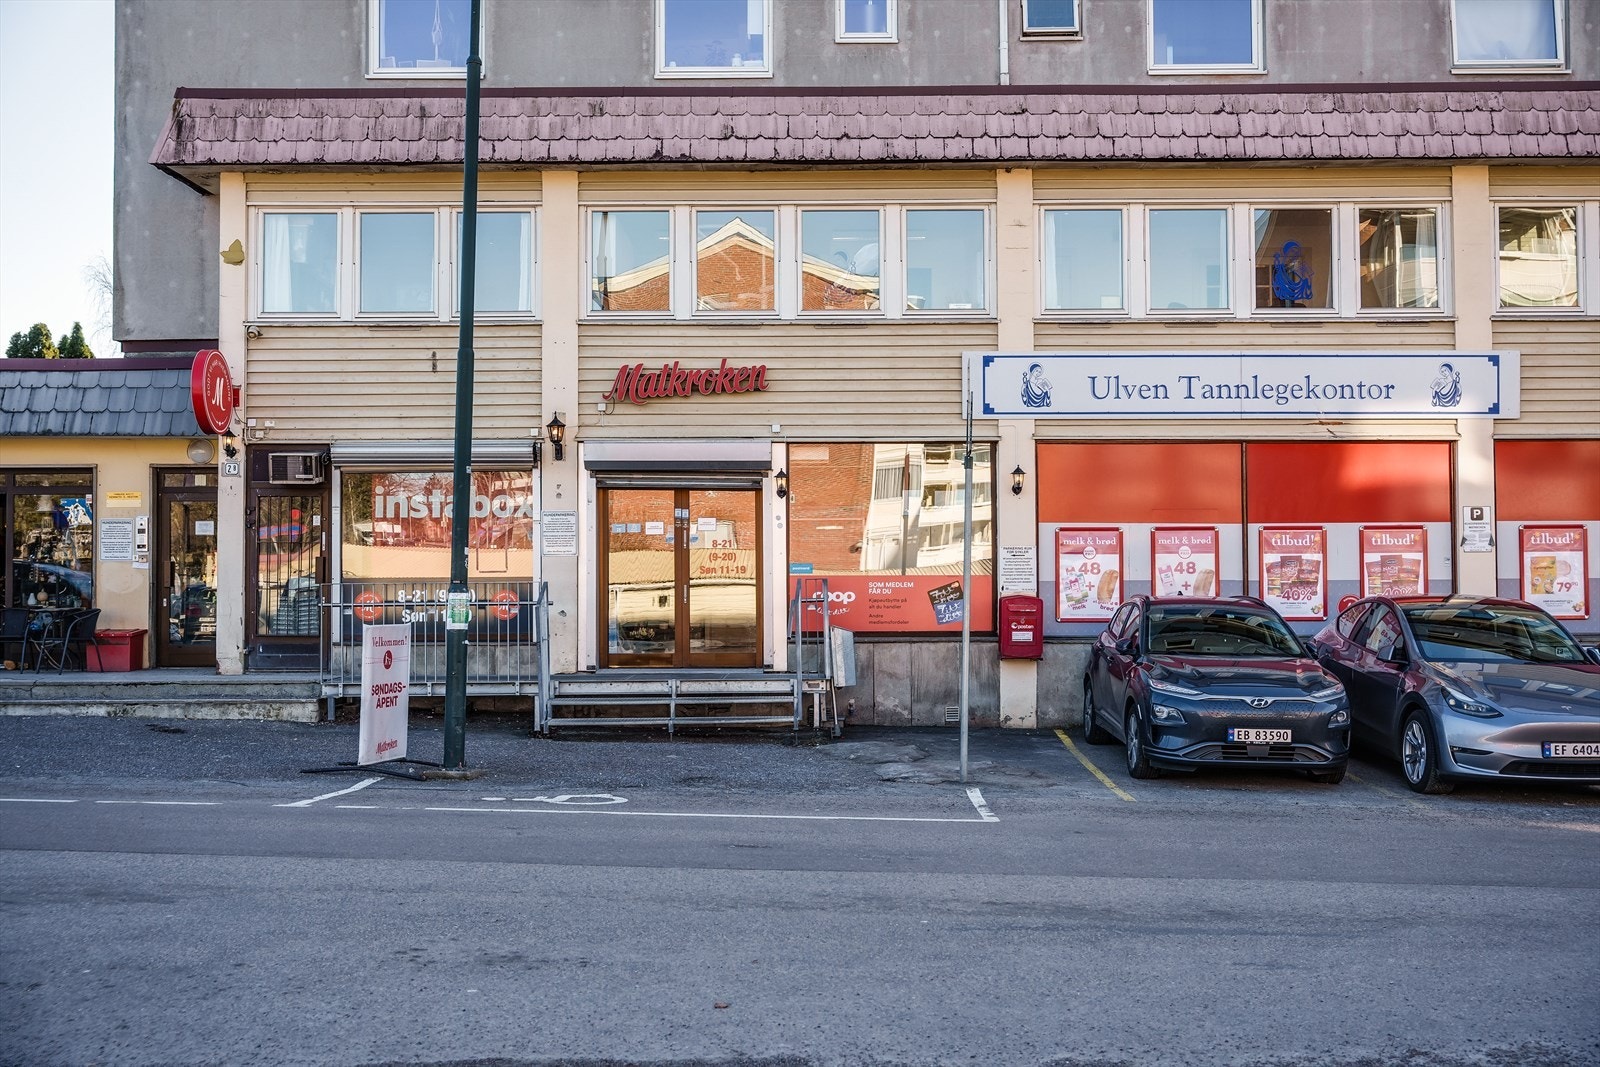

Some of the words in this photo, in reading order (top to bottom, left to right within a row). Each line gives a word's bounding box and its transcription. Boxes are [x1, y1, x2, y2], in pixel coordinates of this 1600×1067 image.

[602, 358, 769, 405] Matkroken
[1087, 374, 1170, 400] Ulven
[1177, 374, 1396, 406] Tannlegekontor
[227, 464, 237, 473] 28
[712, 539, 733, 548] 8-21
[1063, 536, 1085, 545] melk
[1087, 536, 1093, 545] &
[1096, 536, 1117, 545] brød
[1158, 536, 1180, 545] melk
[1182, 536, 1188, 545] &
[1191, 536, 1212, 545] brød
[1271, 534, 1315, 547] tilbud!
[1371, 533, 1415, 546] tilbud!
[1530, 532, 1575, 545] tilbud!
[708, 552, 737, 563] (9-20)
[700, 565, 717, 574] Søn
[719, 565, 747, 574] 11-19
[1078, 562, 1101, 575] 48
[1173, 561, 1197, 575] 48
[1556, 582, 1572, 592] 79
[397, 589, 428, 602] 8-21
[1276, 589, 1312, 601] -40%
[402, 609, 426, 622] Søn
[372, 636, 408, 647] Velkommen!
[371, 682, 406, 696] SØNDAGS-
[376, 694, 398, 709] ÅPENT
[1237, 730, 1250, 740] EB
[1254, 730, 1289, 741] 83590
[1554, 744, 1567, 755] EF
